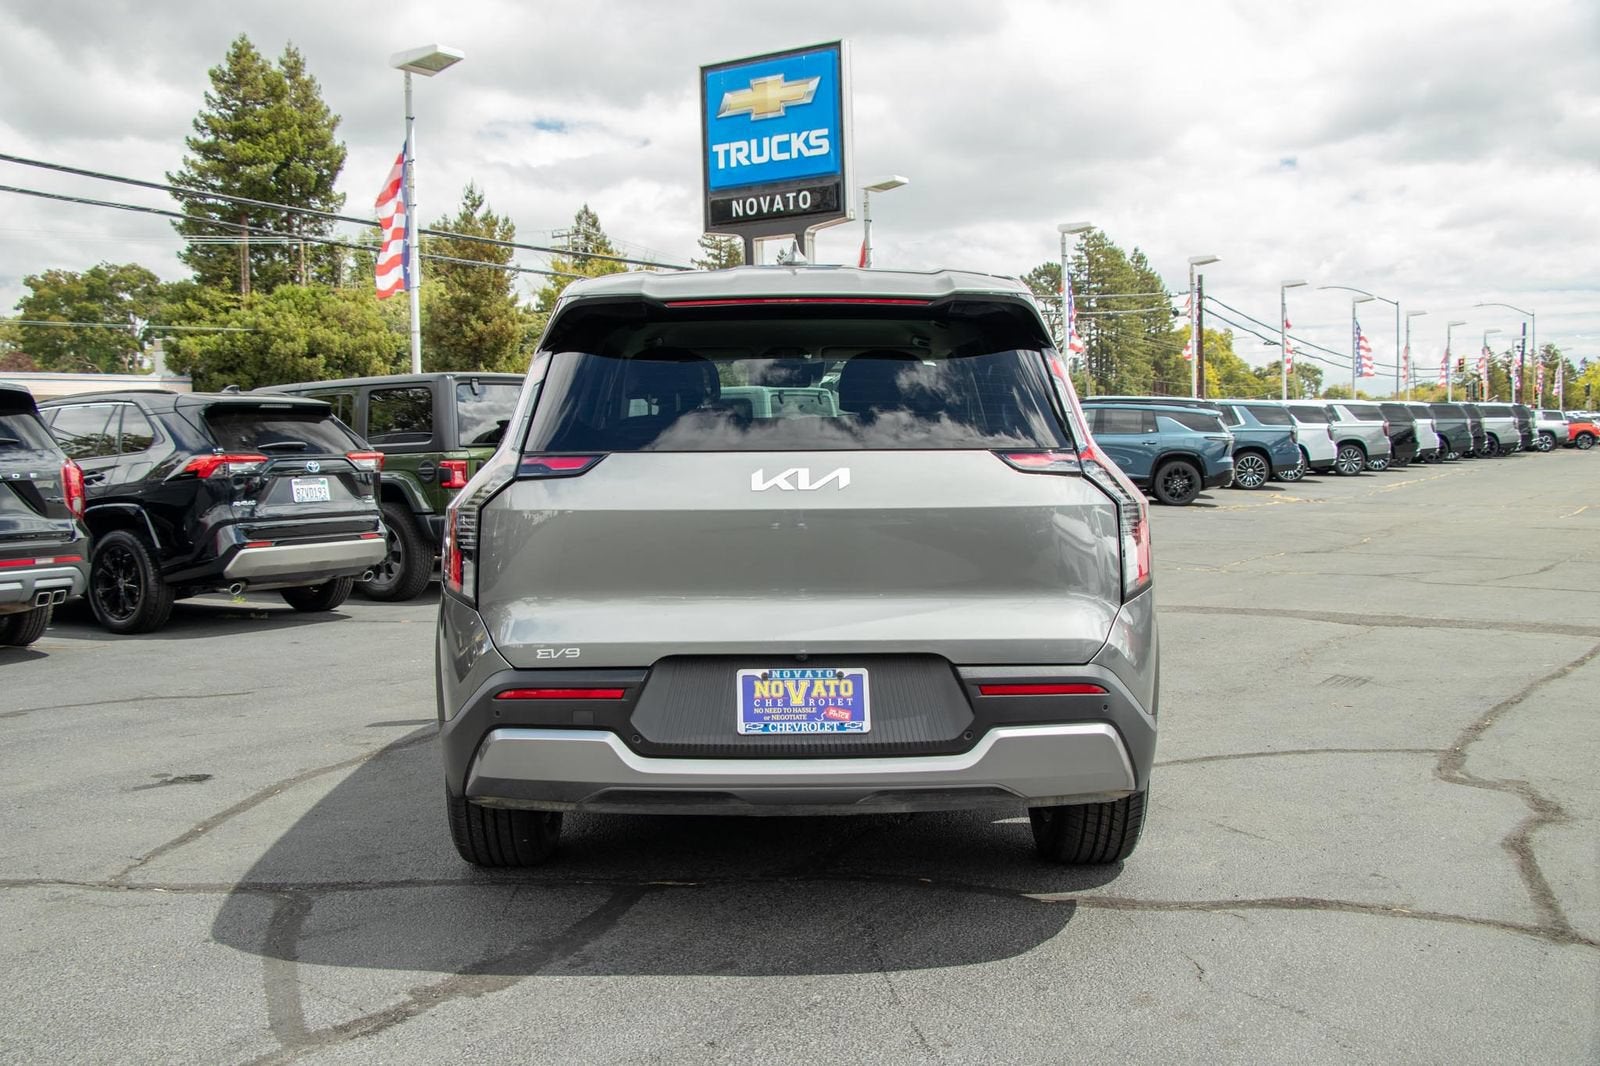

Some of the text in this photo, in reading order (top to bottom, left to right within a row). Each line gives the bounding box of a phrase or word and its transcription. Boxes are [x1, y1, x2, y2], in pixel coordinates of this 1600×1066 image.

[712, 128, 830, 169] TRUCKS
[731, 190, 811, 217] NOVATO
[536, 648, 580, 659] EV9
[772, 670, 834, 679] NOVATO
[754, 679, 854, 706] NOVATO
[792, 706, 817, 714] HASSLE
[768, 722, 840, 732] CHEVROLET
